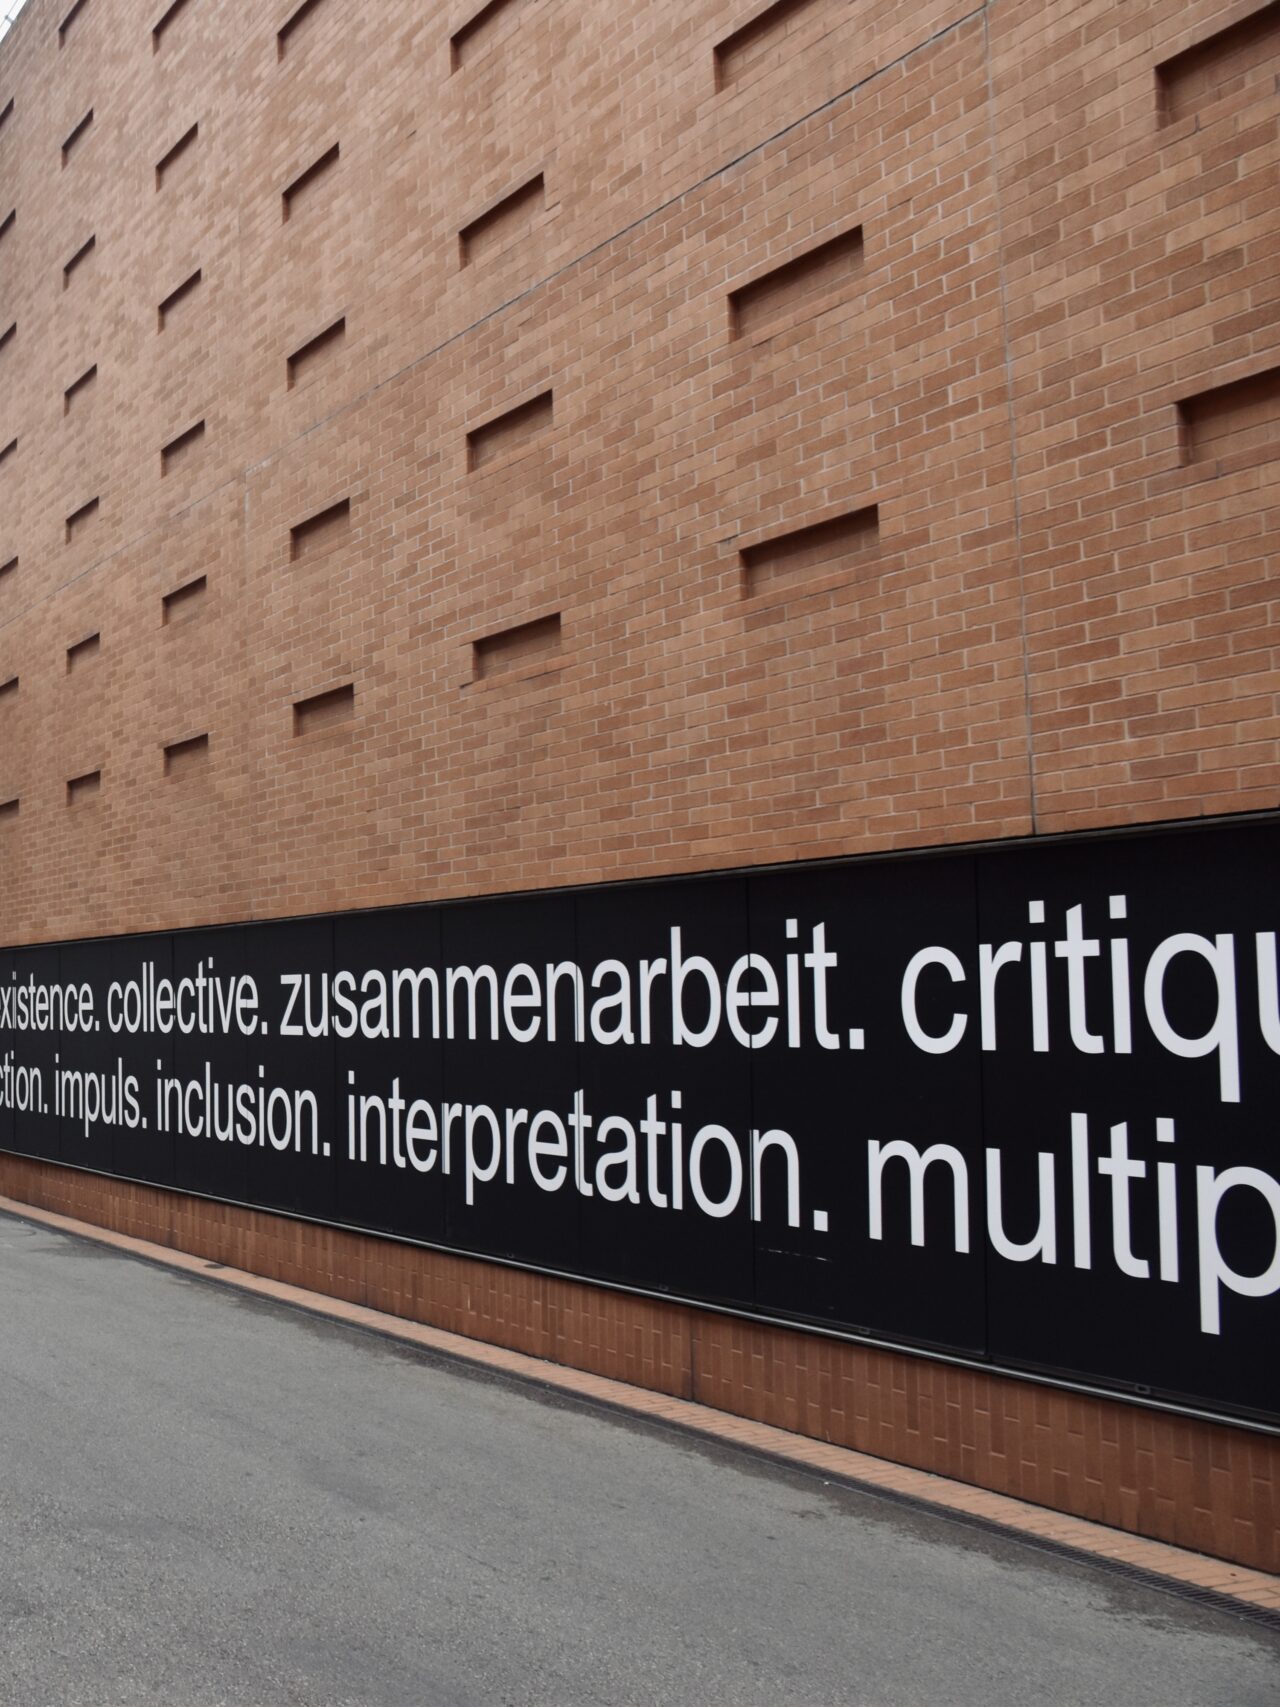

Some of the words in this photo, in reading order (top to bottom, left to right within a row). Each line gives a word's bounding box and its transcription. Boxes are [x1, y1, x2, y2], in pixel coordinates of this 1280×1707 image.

[108, 957, 268, 1036] collective.
[280, 918, 865, 1051] zusammenarbeit.
[55, 1053, 148, 1138] impuls.
[156, 1058, 331, 1157] inclusion.
[348, 1070, 829, 1232] interpretation.
[867, 1112, 1280, 1336] multip
